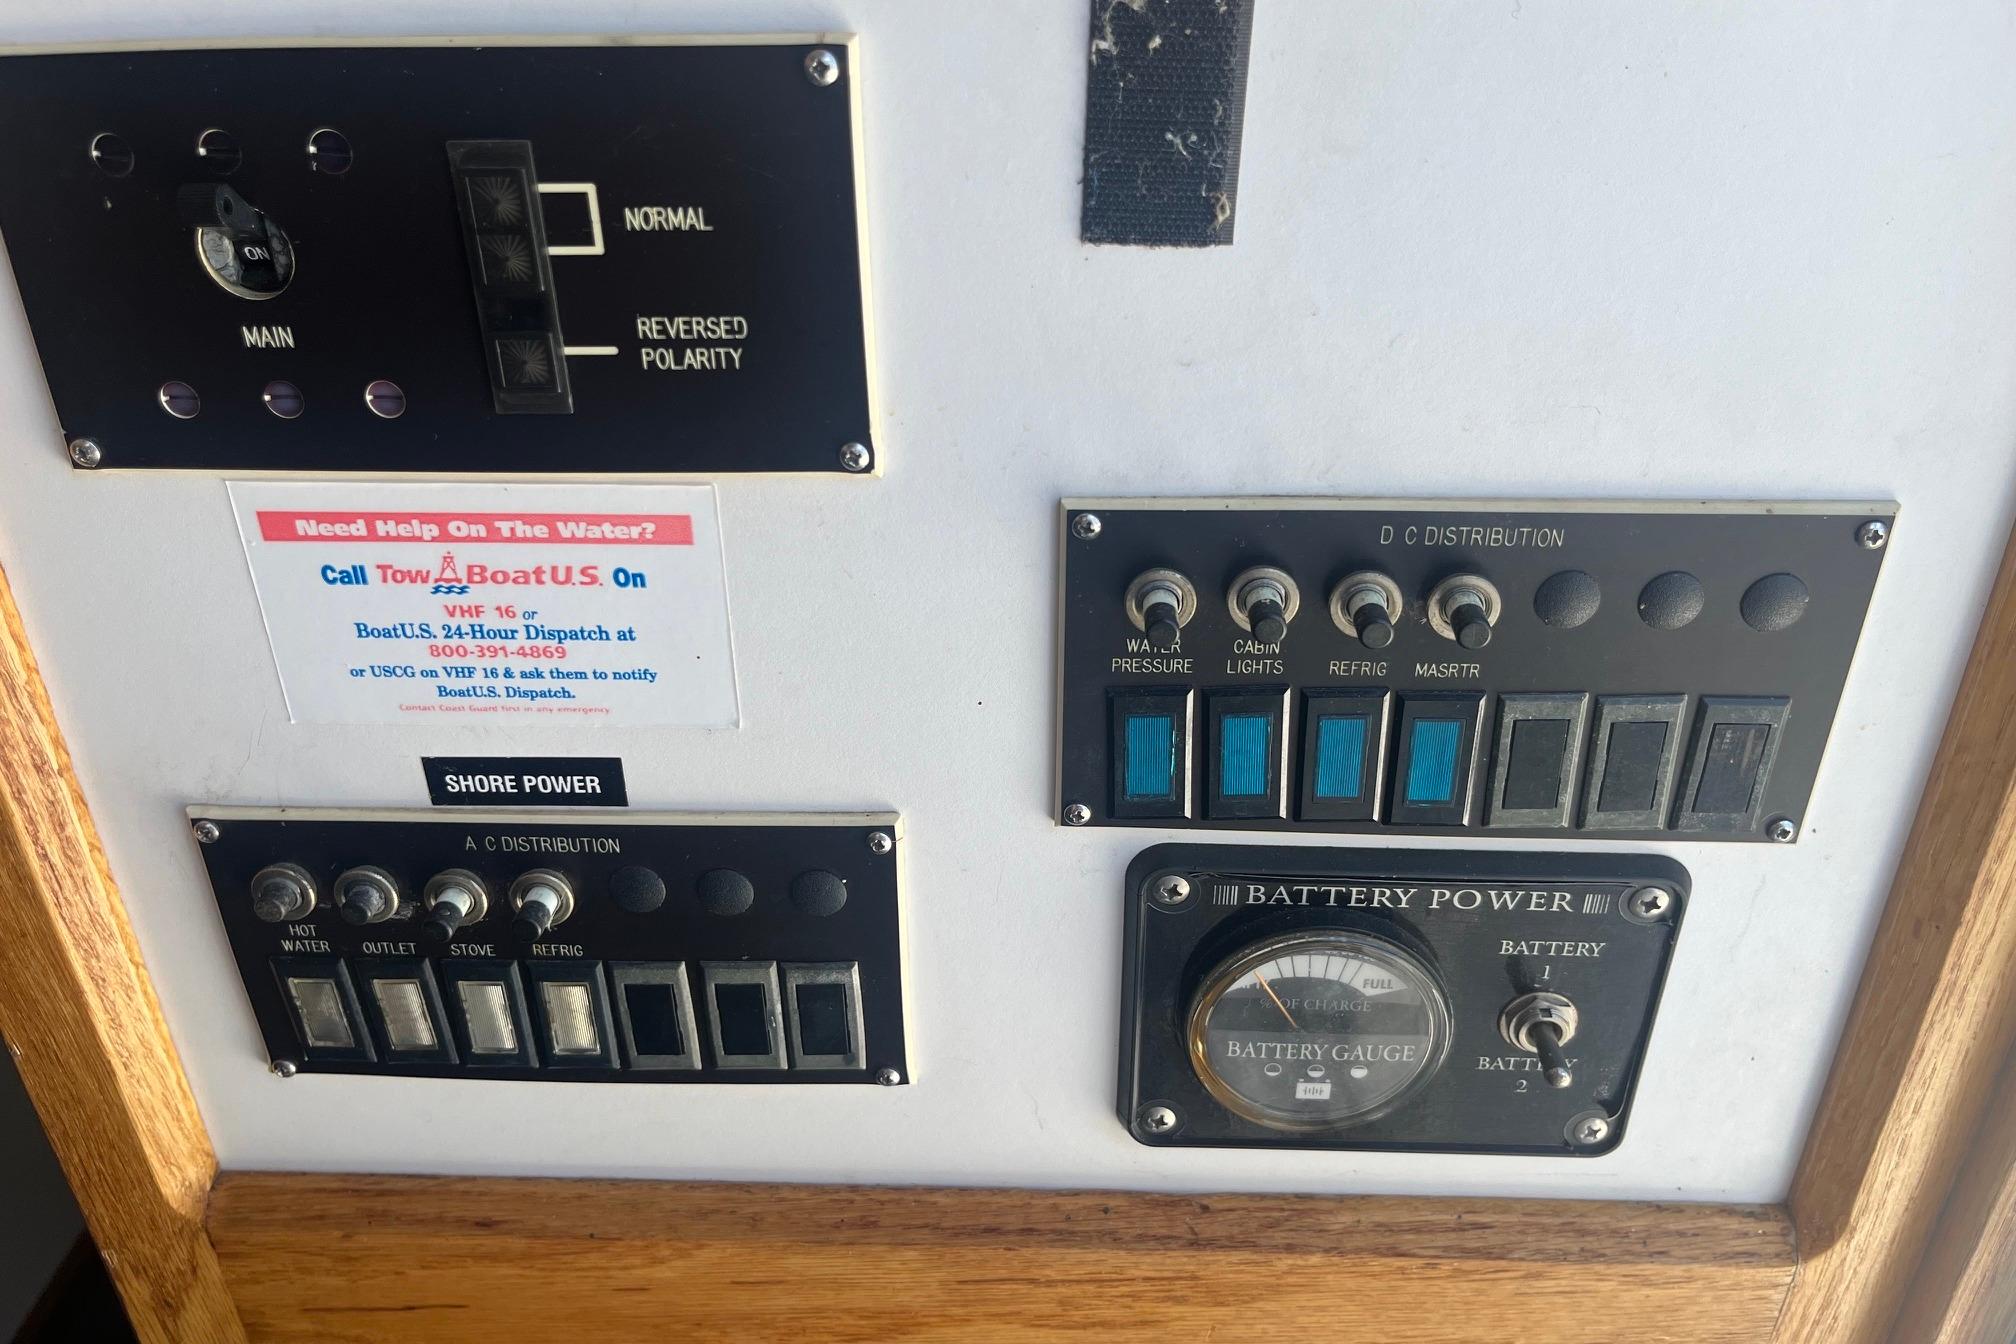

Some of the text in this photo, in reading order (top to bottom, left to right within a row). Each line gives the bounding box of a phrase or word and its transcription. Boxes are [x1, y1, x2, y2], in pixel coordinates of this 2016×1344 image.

[624, 206, 714, 231] NORMAL
[244, 246, 271, 261] ON
[636, 316, 749, 340] REVERSED
[242, 325, 296, 349] MAIN
[640, 347, 743, 370] POLARITY
[295, 518, 657, 541] Need Help On The Water?
[1424, 525, 1566, 548] DISTRIBUTION
[320, 564, 369, 586] Call
[612, 566, 648, 588] On
[443, 604, 538, 621] VHF 16 or
[354, 622, 637, 644] BoatU.S. 24-Hour Dispatch at
[427, 644, 568, 659] 800-391-4869
[1111, 657, 1194, 674] PRESSURE
[1226, 659, 1285, 675] LIGHTS
[1329, 660, 1388, 677] REFRIG
[1414, 662, 1481, 679] MASRTR
[350, 665, 658, 684] or USCG on VHF 16 & ask them to notify
[436, 685, 577, 701] BoatU.S. Dispatch.
[445, 774, 603, 795] SHORE POWER
[501, 836, 622, 855] DISTRIBUTION
[1245, 884, 1575, 912] BATTERY POWER
[288, 923, 318, 938] HOT
[280, 939, 331, 953] WATER
[362, 941, 418, 956] OUTLET
[450, 943, 497, 957] STOVE
[532, 943, 585, 958] REFRIG
[1499, 939, 1606, 958] BATTERY
[1541, 964, 1551, 981] 1
[1362, 978, 1394, 991] FULL
[1303, 999, 1373, 1013] CHARGE
[1227, 1040, 1416, 1062] BATTERY GAUGE
[1513, 1079, 1529, 1094] 2
